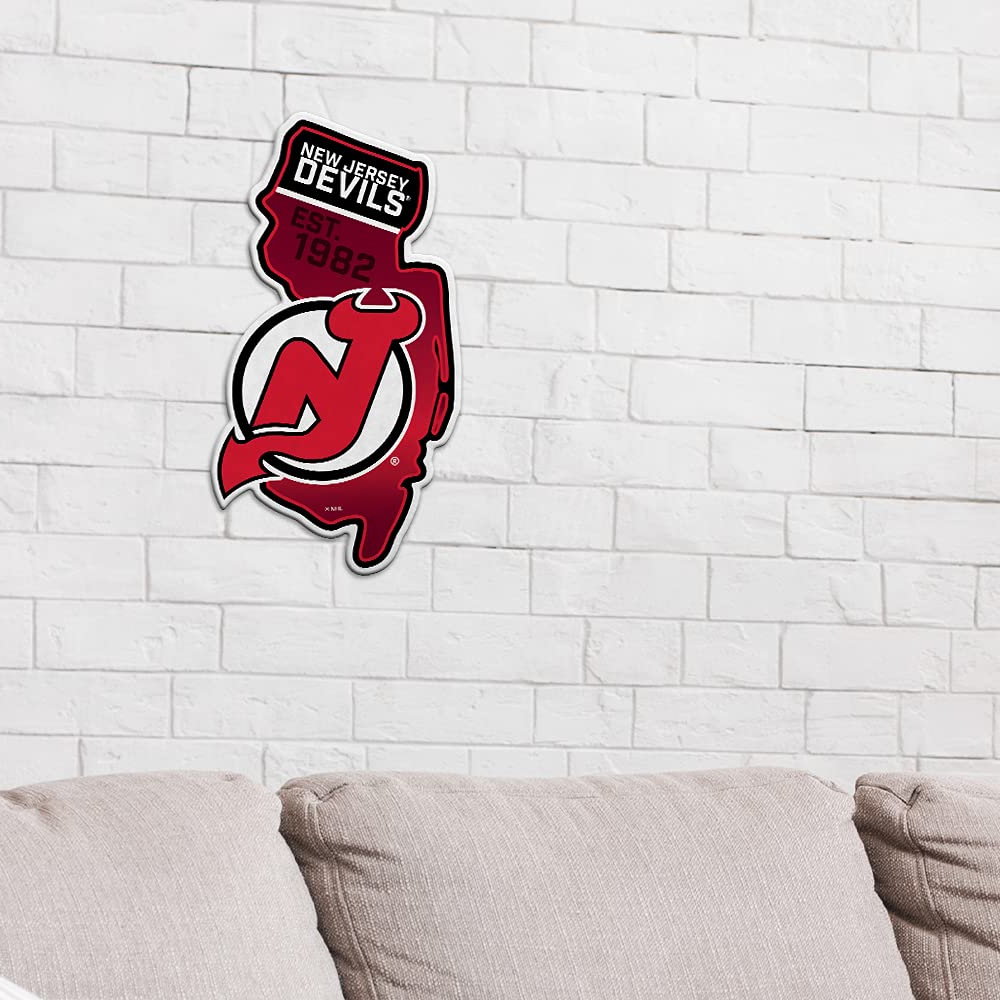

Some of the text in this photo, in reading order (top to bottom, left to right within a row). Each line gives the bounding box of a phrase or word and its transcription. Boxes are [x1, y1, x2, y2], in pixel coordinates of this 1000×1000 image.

[293, 156, 406, 217] DEVILS
[300, 141, 410, 192] NEW JERSEY
[290, 206, 340, 241] EST.
[294, 233, 376, 283] 1982
